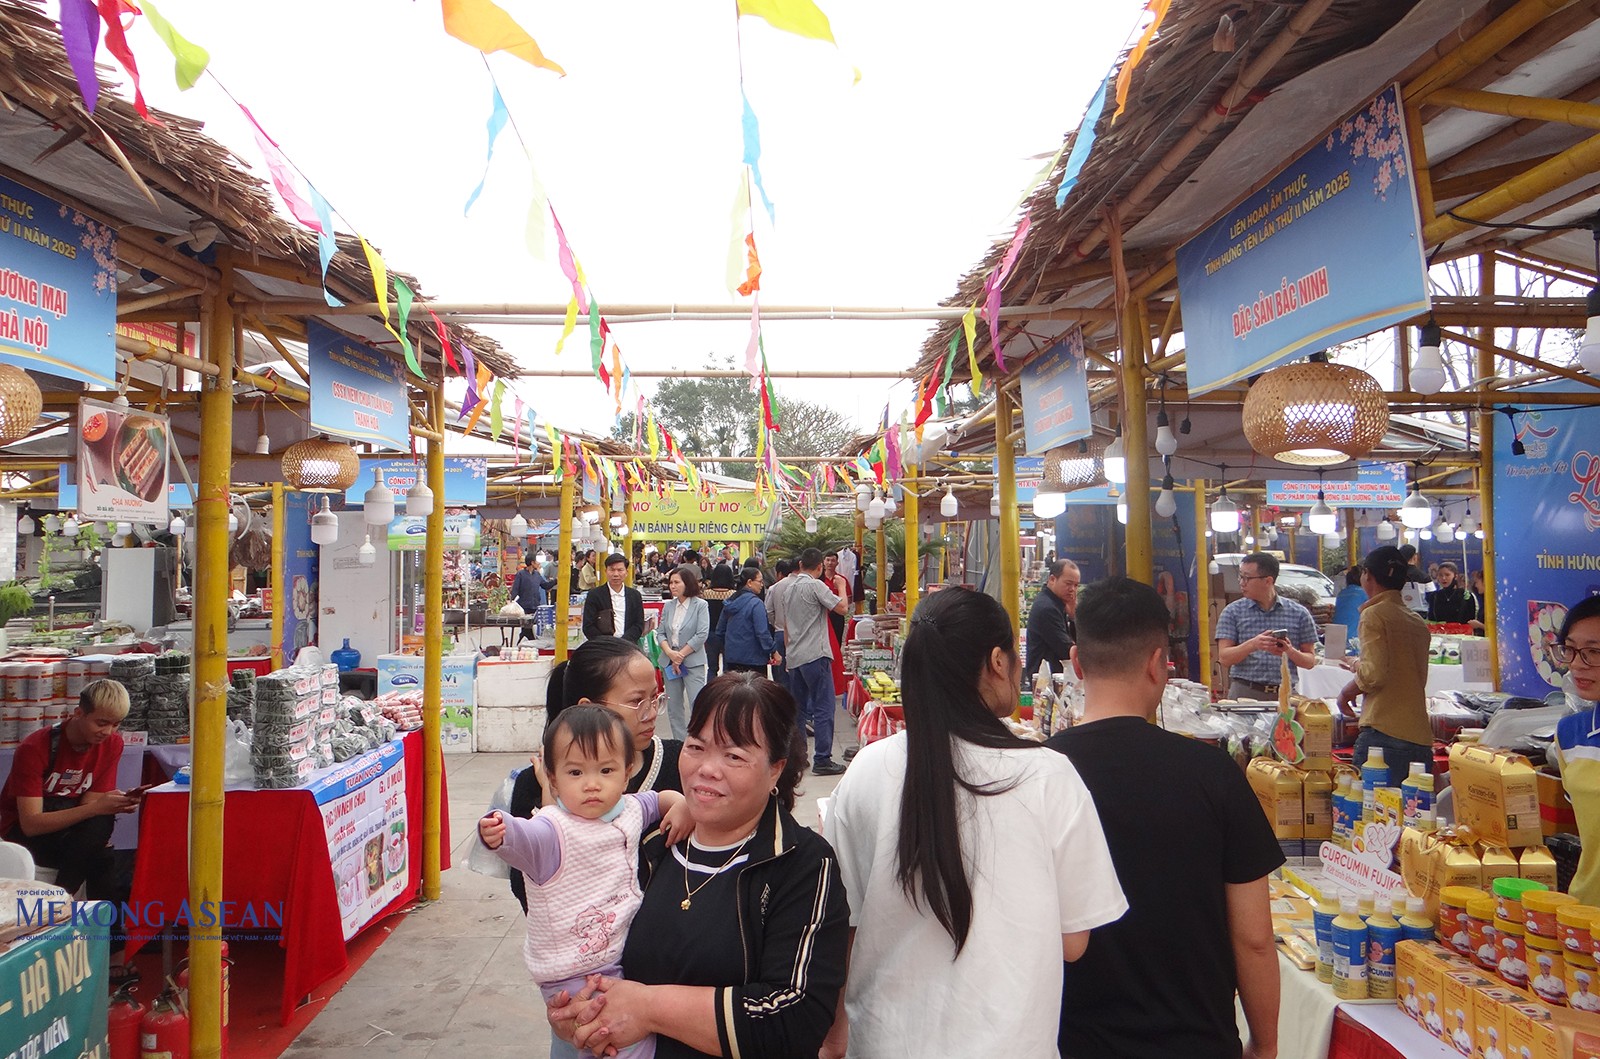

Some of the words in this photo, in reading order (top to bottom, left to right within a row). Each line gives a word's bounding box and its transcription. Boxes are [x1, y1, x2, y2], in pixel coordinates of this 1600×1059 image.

[1204, 257, 1221, 277] TỈNH
[1221, 244, 1243, 267] HƯNG
[1243, 232, 1258, 253] YÊN
[1260, 220, 1275, 244] LẦN
[1275, 205, 1293, 232] THỨ
[1302, 190, 1323, 215] NĂM
[1325, 171, 1350, 199] 2025
[1230, 215, 1246, 240] LIÊN
[1247, 205, 1269, 228] HOAN
[1269, 189, 1283, 212] ẨM
[1282, 173, 1308, 203] THỰC
[13, 222, 21, 237] II
[24, 226, 50, 249] NĂM
[51, 238, 77, 260] 2025
[41, 283, 67, 320] MẠI
[1232, 304, 1252, 340] ĐẶC
[1253, 290, 1274, 327] SẢN
[1274, 276, 1298, 318] BẮC
[1298, 265, 1329, 306] NINH
[24, 316, 48, 352] NỘI
[388, 475, 406, 485] CÔNG
[1323, 492, 1340, 501] ƯỠNG
[700, 500, 716, 512] ÚT
[719, 502, 740, 513] MƠ
[647, 520, 674, 533] BÁNH
[698, 520, 728, 534] RIÊNG
[753, 523, 766, 534] TH
[1536, 549, 1564, 569] TỈNH
[1321, 845, 1370, 879] CURCUMIN
[20, 950, 50, 1018] HÀ
[54, 929, 92, 997] NỘI
[43, 1015, 70, 1054] VIÊN
